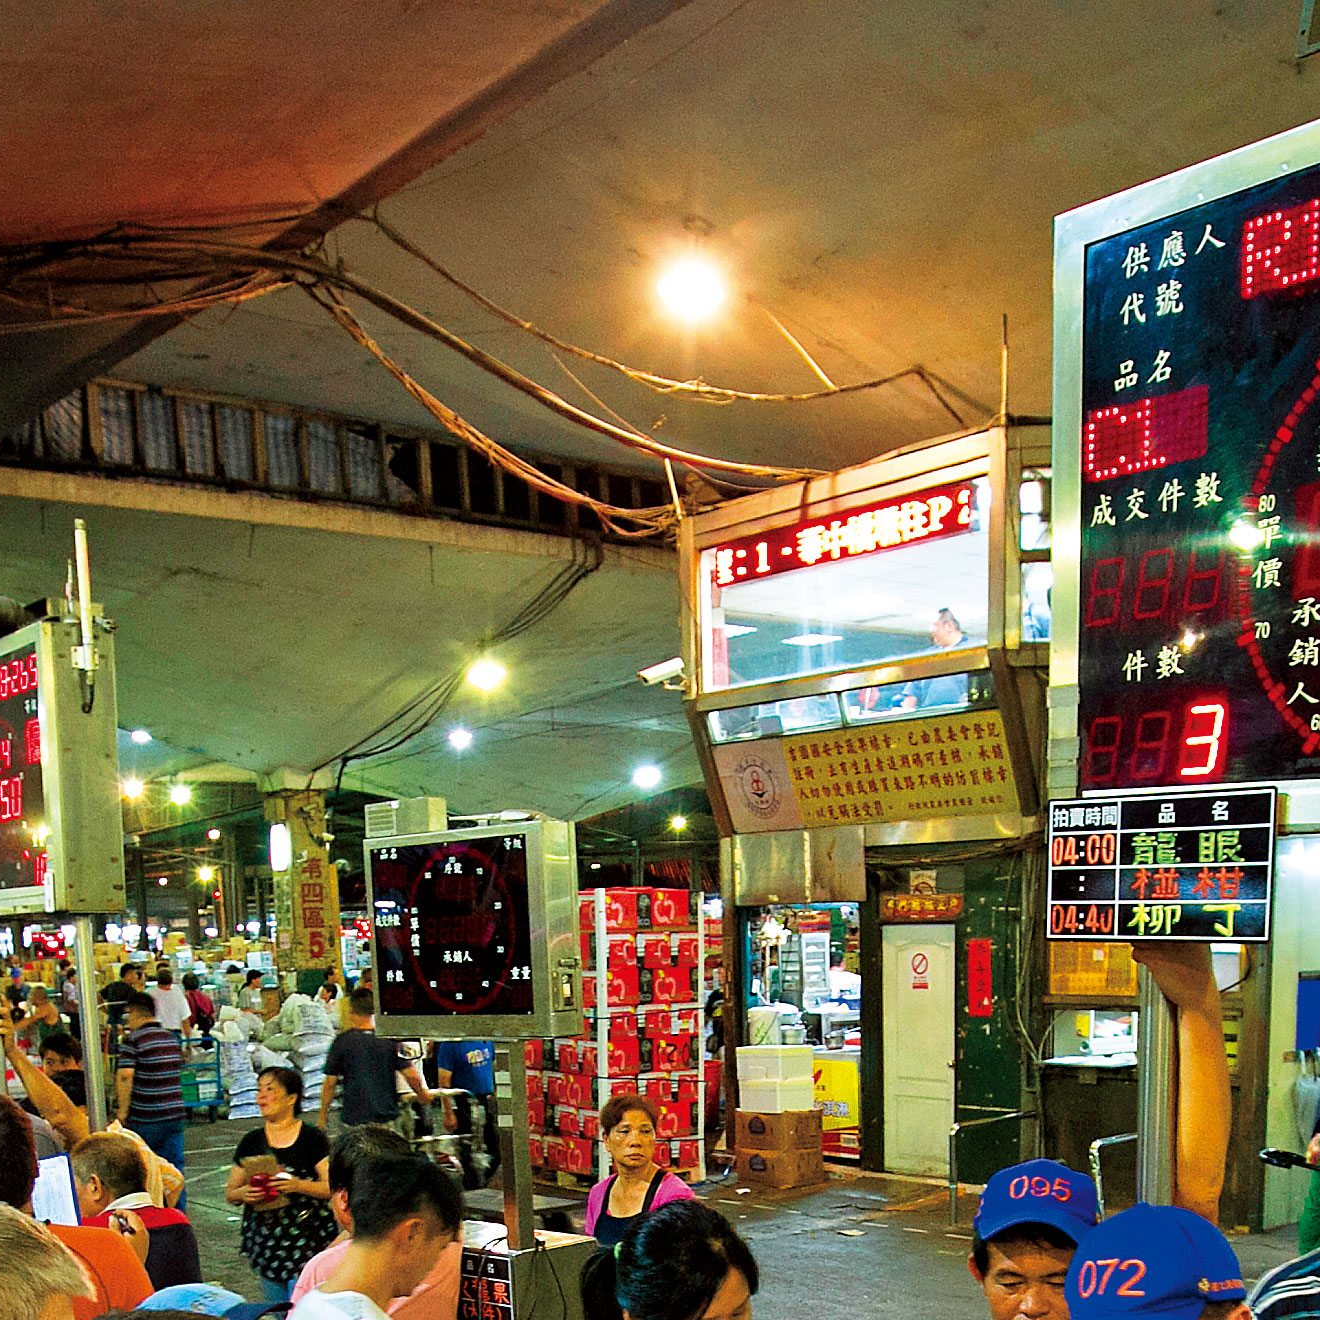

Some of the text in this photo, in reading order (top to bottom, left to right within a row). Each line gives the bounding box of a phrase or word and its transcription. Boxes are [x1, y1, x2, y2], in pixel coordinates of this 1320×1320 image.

[1122, 224, 1226, 278] 供應人
[1120, 279, 1184, 325] 代號
[1114, 349, 1172, 392] 品名
[1090, 472, 1223, 527] 成交件數
[1258, 495, 1277, 513] 80
[1251, 515, 1284, 589] 單價
[1254, 622, 1271, 639] 70
[1122, 645, 1184, 682] 件數
[1181, 704, 1225, 776] 3
[1053, 805, 1118, 828] 拍賣時間
[1158, 800, 1229, 824] 品名
[1131, 830, 1245, 866] 龍眼
[1131, 866, 1245, 899] 椪柑
[1128, 904, 1242, 937] 柳丁
[1009, 1176, 1072, 1202] 095
[1079, 1258, 1148, 1299] 072
